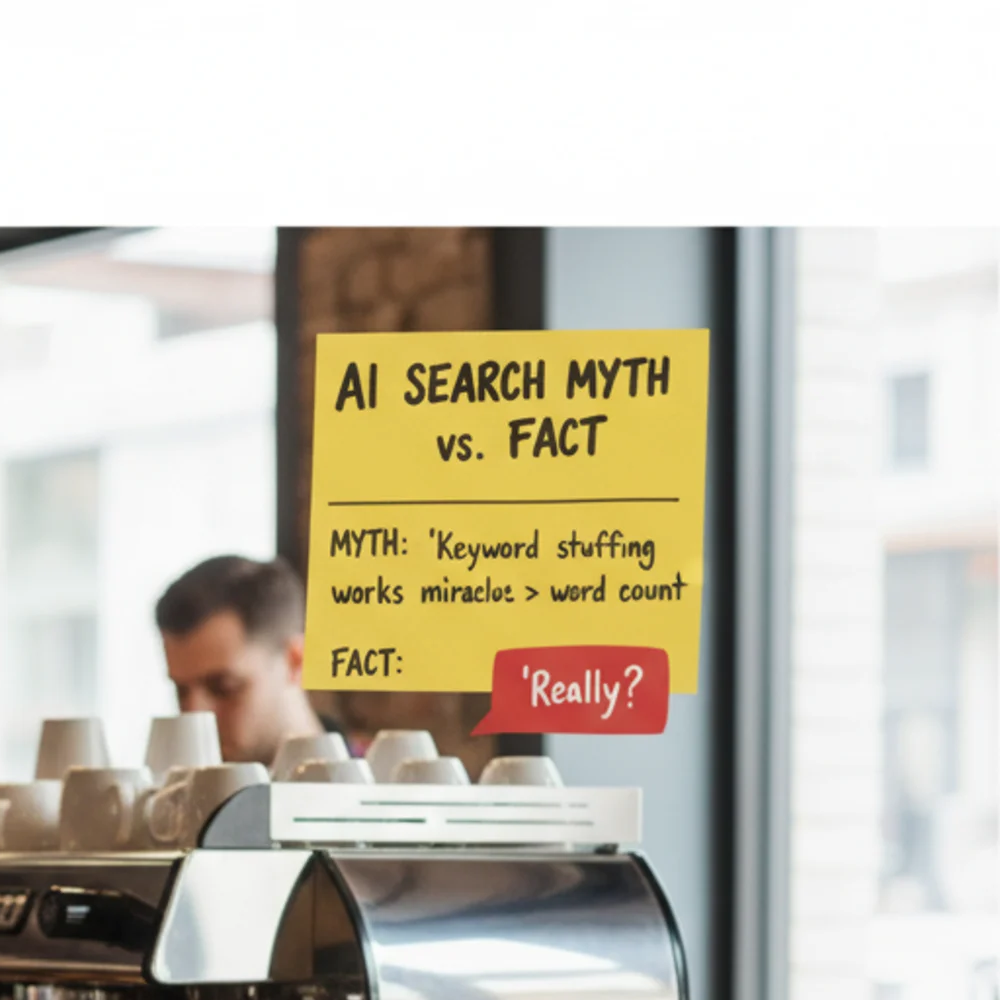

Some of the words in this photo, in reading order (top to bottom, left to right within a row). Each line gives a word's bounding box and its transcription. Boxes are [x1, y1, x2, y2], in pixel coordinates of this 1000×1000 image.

[335, 362, 378, 412] AI
[403, 359, 546, 406] SEARCH
[566, 355, 671, 400] MYTH
[436, 433, 485, 462] vs.
[507, 414, 609, 460] FACT
[329, 527, 408, 559] MYTH:
[556, 529, 656, 571] stuffing
[331, 575, 404, 605] works
[550, 574, 606, 603] word
[618, 571, 688, 603] count
[331, 646, 403, 678] FACT:
